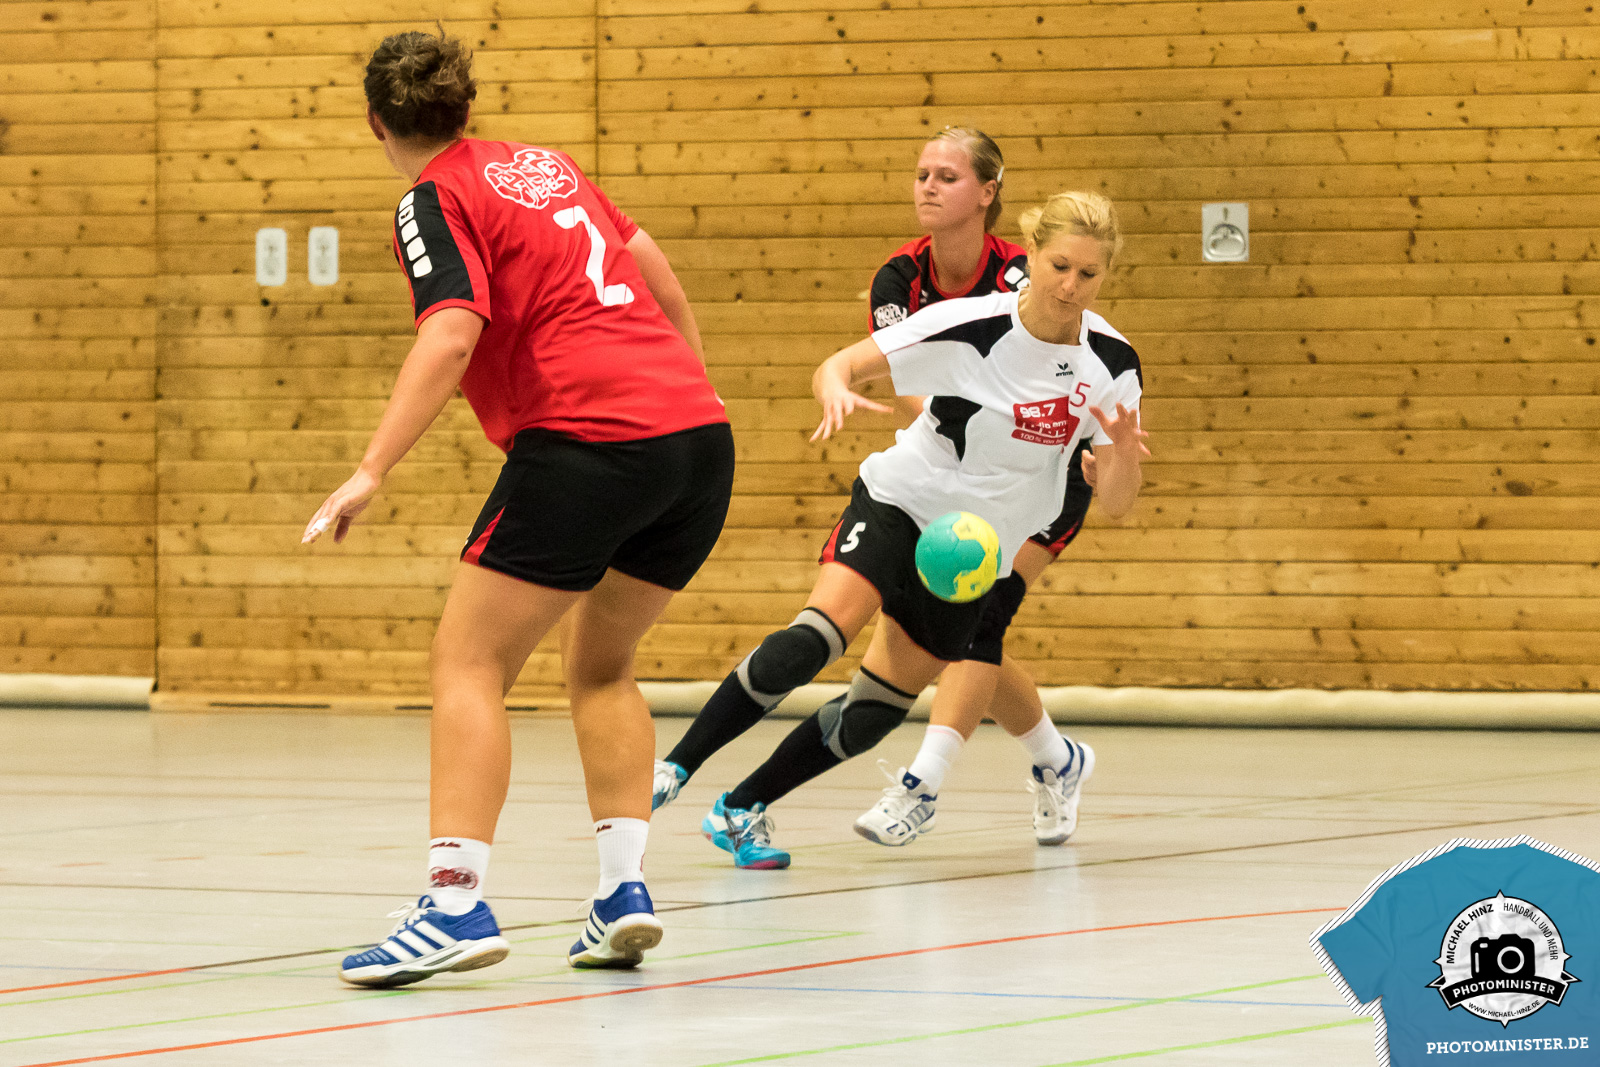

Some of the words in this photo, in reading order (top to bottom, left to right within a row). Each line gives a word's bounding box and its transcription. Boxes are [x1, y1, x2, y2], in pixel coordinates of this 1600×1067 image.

[552, 205, 635, 306] 2
[1069, 381, 1091, 408] 5
[1019, 402, 1056, 419] 98.7
[839, 521, 867, 554] 5
